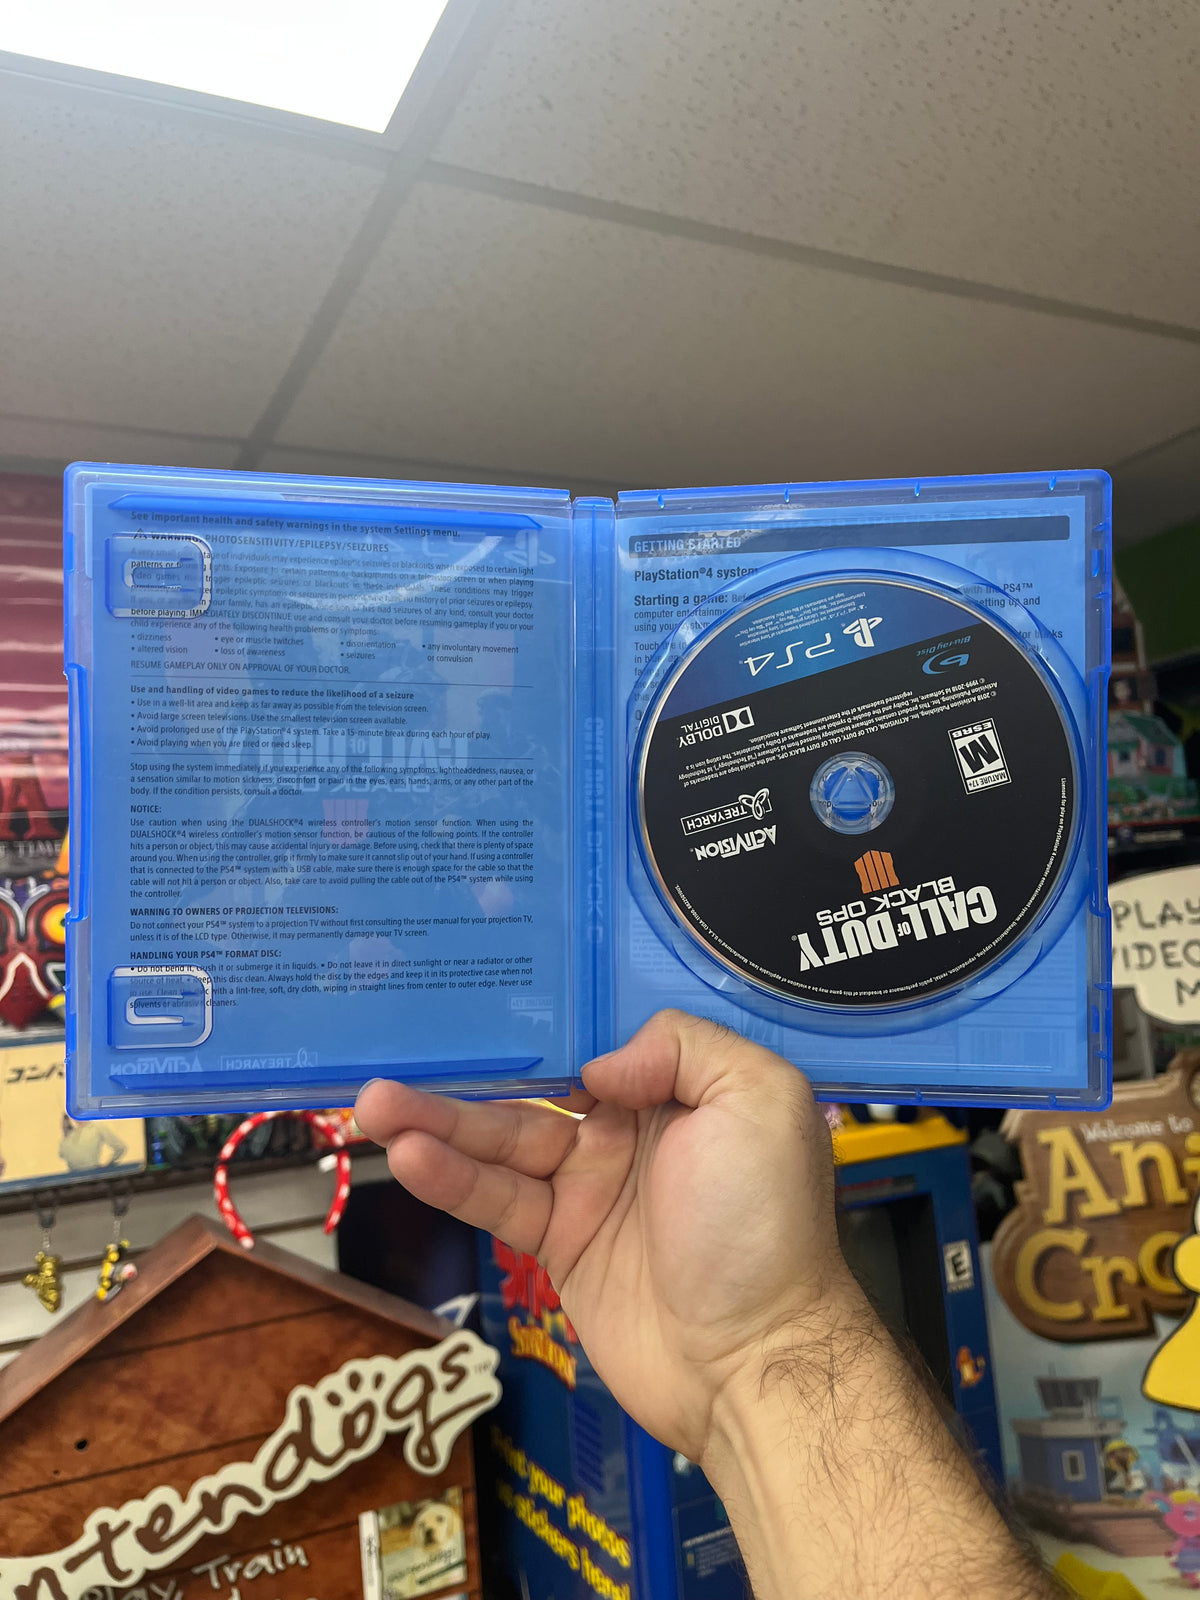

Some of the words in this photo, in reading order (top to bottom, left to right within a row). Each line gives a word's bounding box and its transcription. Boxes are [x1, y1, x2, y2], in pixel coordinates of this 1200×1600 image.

[131, 511, 149, 521] See
[152, 512, 199, 526] important
[202, 515, 233, 525] health
[235, 517, 253, 526] and
[255, 518, 284, 530] safety
[287, 519, 329, 532] warnings
[331, 522, 340, 531] in
[342, 522, 357, 531] the
[359, 523, 391, 535] system
[394, 525, 431, 537] Settings
[433, 529, 461, 537] menu.
[205, 534, 389, 552] PHOTOSENSITIVITY/EPILEPSY/SEIZURES
[634, 540, 684, 553] GETTING
[689, 536, 741, 550] STARTED
[634, 594, 681, 607] Starting
[684, 596, 689, 604] a
[693, 594, 728, 607] game:
[1023, 597, 1040, 605] and
[634, 611, 678, 620] computer
[634, 623, 656, 632] using
[137, 633, 172, 642] dizziness
[220, 637, 234, 645] eye
[246, 636, 271, 644] muscle
[273, 637, 304, 645] twitches
[937, 635, 971, 652] Blu-ray
[137, 645, 164, 653] altered
[166, 646, 187, 654] vision
[346, 640, 396, 649] disorientation
[427, 645, 440, 653] any
[442, 643, 481, 654] involuntary
[483, 644, 519, 653] movement
[634, 642, 659, 651] Touch
[220, 647, 235, 655] loss
[237, 648, 245, 656] of
[346, 652, 376, 660] seizures
[744, 633, 835, 676] PS4
[916, 647, 936, 656] Disc
[436, 654, 473, 663] convulsion
[131, 660, 161, 669] RESUME
[163, 661, 205, 670] GAMEPLAY
[207, 662, 227, 670] ONLY
[229, 663, 240, 671] ON
[242, 663, 282, 672] APPROVAL
[284, 664, 294, 672] OF
[296, 665, 316, 673] YOUR
[319, 665, 351, 674] DOCTOR.
[131, 685, 145, 693] Use
[148, 685, 164, 694] and
[166, 686, 203, 696] handling
[205, 687, 214, 695] of
[216, 687, 240, 695] video
[242, 689, 269, 698] games
[271, 688, 279, 696] to
[281, 688, 309, 697] reduce
[311, 689, 324, 697] the
[326, 689, 367, 698] likelihood
[369, 690, 377, 698] of
[386, 690, 414, 699] seizure
[976, 691, 990, 701] 2018
[948, 694, 977, 709] Activision
[681, 715, 720, 733] DIGITAL
[803, 712, 841, 728] Entertainment
[779, 723, 803, 735] Software
[864, 725, 878, 734] CALL
[952, 721, 992, 738] ESRB
[678, 725, 723, 748] DOLBY
[827, 736, 841, 745] CALL
[137, 738, 159, 746] Avoid
[161, 739, 188, 748] playing
[190, 739, 211, 747] when
[213, 741, 226, 749] you
[271, 740, 289, 748] need
[291, 740, 312, 750] sleep.
[805, 742, 820, 751] DUTY
[788, 746, 805, 756] BLACK
[958, 733, 1000, 774] M
[968, 779, 979, 788] 17+
[980, 772, 1006, 786] MATURE
[130, 805, 162, 813] NOTICE:
[686, 805, 747, 830] TREYARCH
[694, 825, 777, 860] ACTIVISION
[130, 890, 142, 898] the
[144, 890, 182, 898] controller.
[870, 876, 955, 912] BLACK
[131, 907, 170, 916] WARNING
[172, 907, 183, 915] TO
[186, 907, 221, 915] OWNERS
[223, 906, 233, 915] OF
[236, 906, 283, 915] PROJECTION
[285, 905, 339, 914] TELEVISIONS:
[816, 900, 867, 926] OPS
[902, 886, 997, 940] CALL
[1113, 898, 1200, 930] PLAY
[897, 921, 911, 937] OF
[797, 911, 899, 971] DUTY
[130, 951, 173, 959] HANDLING
[175, 951, 198, 959] YOUR
[225, 950, 259, 958] FORMAT
[261, 949, 282, 958] DISC:
[1112, 940, 1200, 970] IDEO
[1080, 1119, 1162, 1143] Welcome
[1168, 1113, 1193, 1133] to
[952, 1253, 967, 1278] E
[192, 1538, 309, 1589] Train
